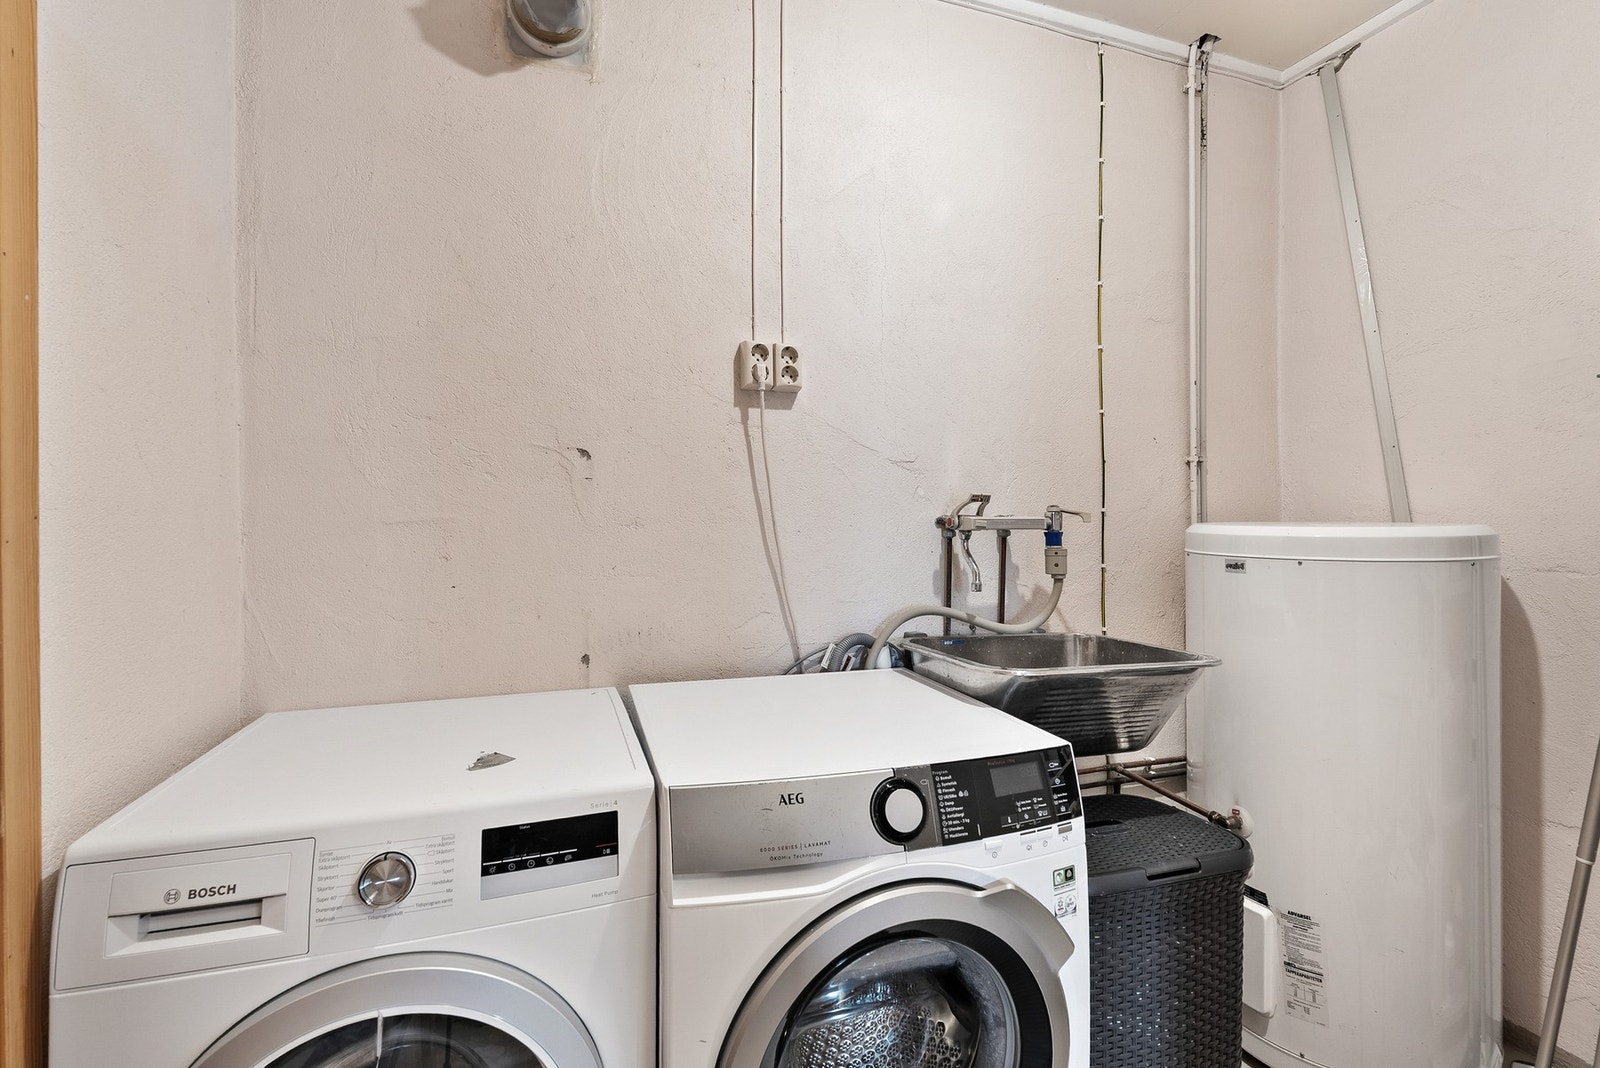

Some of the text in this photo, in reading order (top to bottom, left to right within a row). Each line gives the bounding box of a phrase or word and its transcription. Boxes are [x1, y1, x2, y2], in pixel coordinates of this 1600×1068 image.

[778, 792, 805, 806] AEG
[804, 840, 831, 848] LAVAMAT
[188, 884, 237, 900] BOSCH
